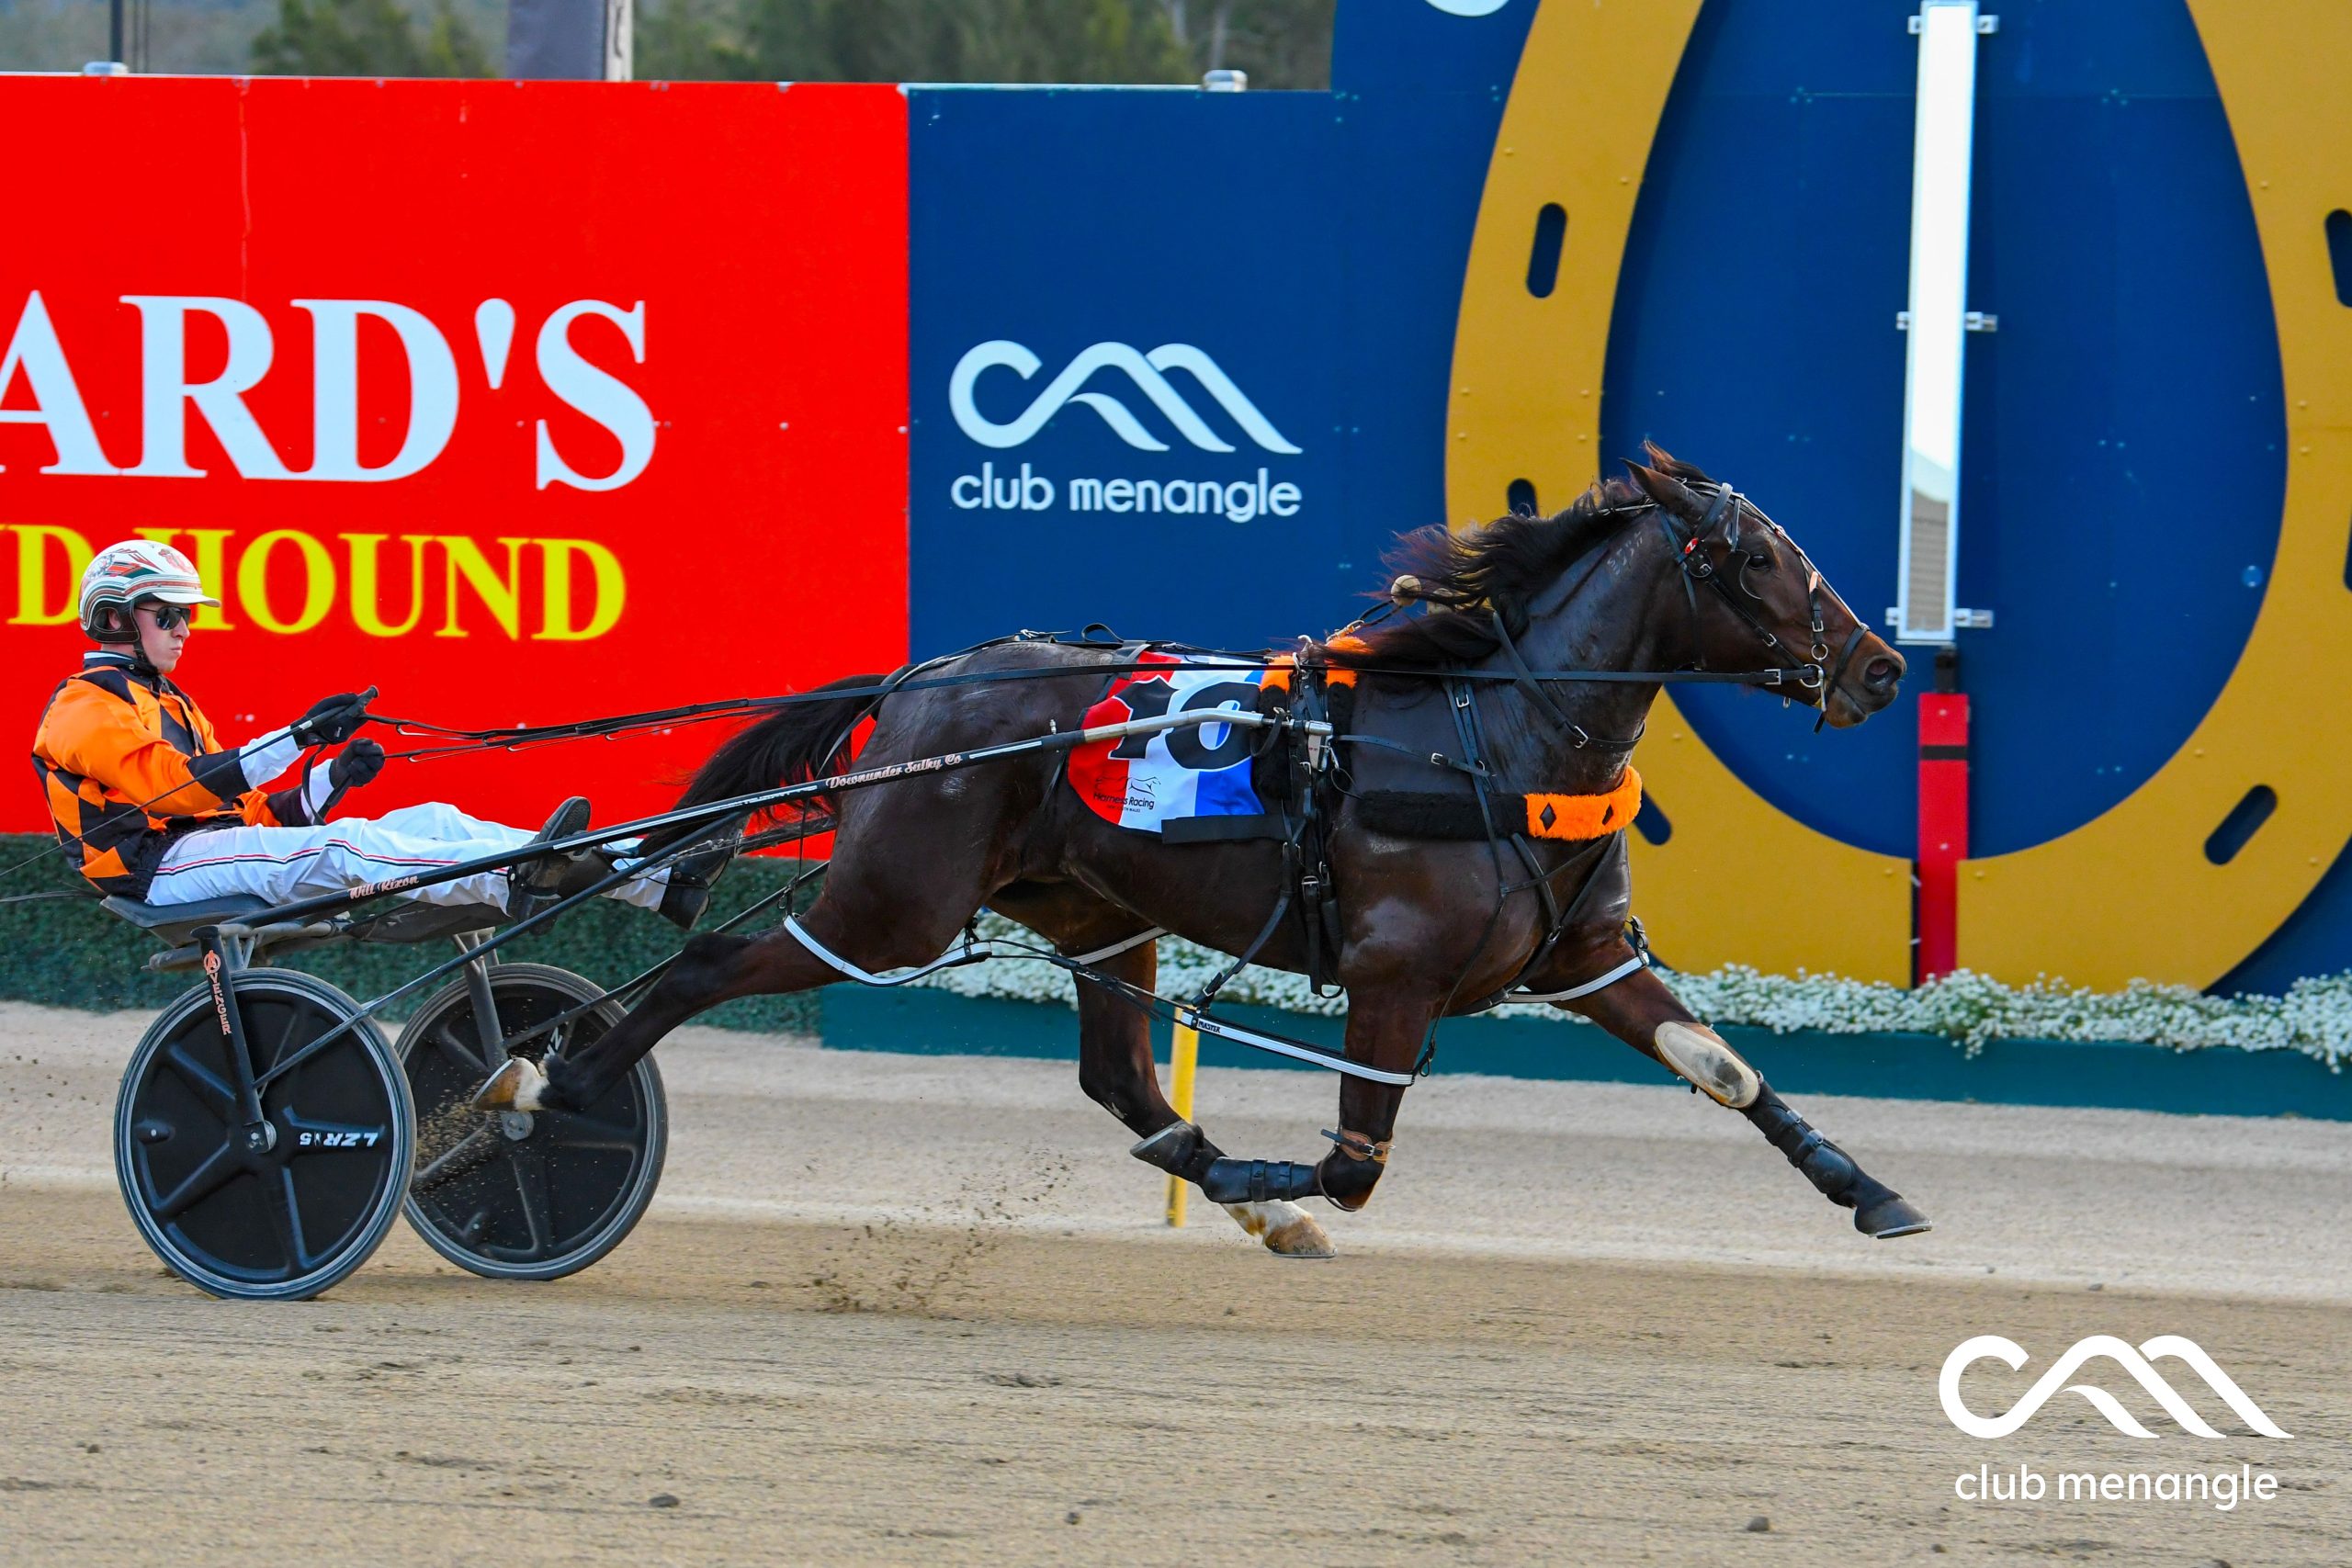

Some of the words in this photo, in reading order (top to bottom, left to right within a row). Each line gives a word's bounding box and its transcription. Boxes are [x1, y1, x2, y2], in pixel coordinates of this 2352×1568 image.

[950, 461, 1056, 512] club
[1069, 467, 1303, 524] menangle
[825, 766, 903, 789] Downunder
[904, 758, 943, 774] Sulky
[944, 753, 964, 766] Co
[1093, 792, 1128, 806] Harness
[1129, 795, 1155, 810] Racing
[348, 883, 376, 899] Will
[378, 875, 420, 892] Rixon
[203, 949, 232, 1035] AVENGER
[1198, 1020, 1221, 1033] MASTER
